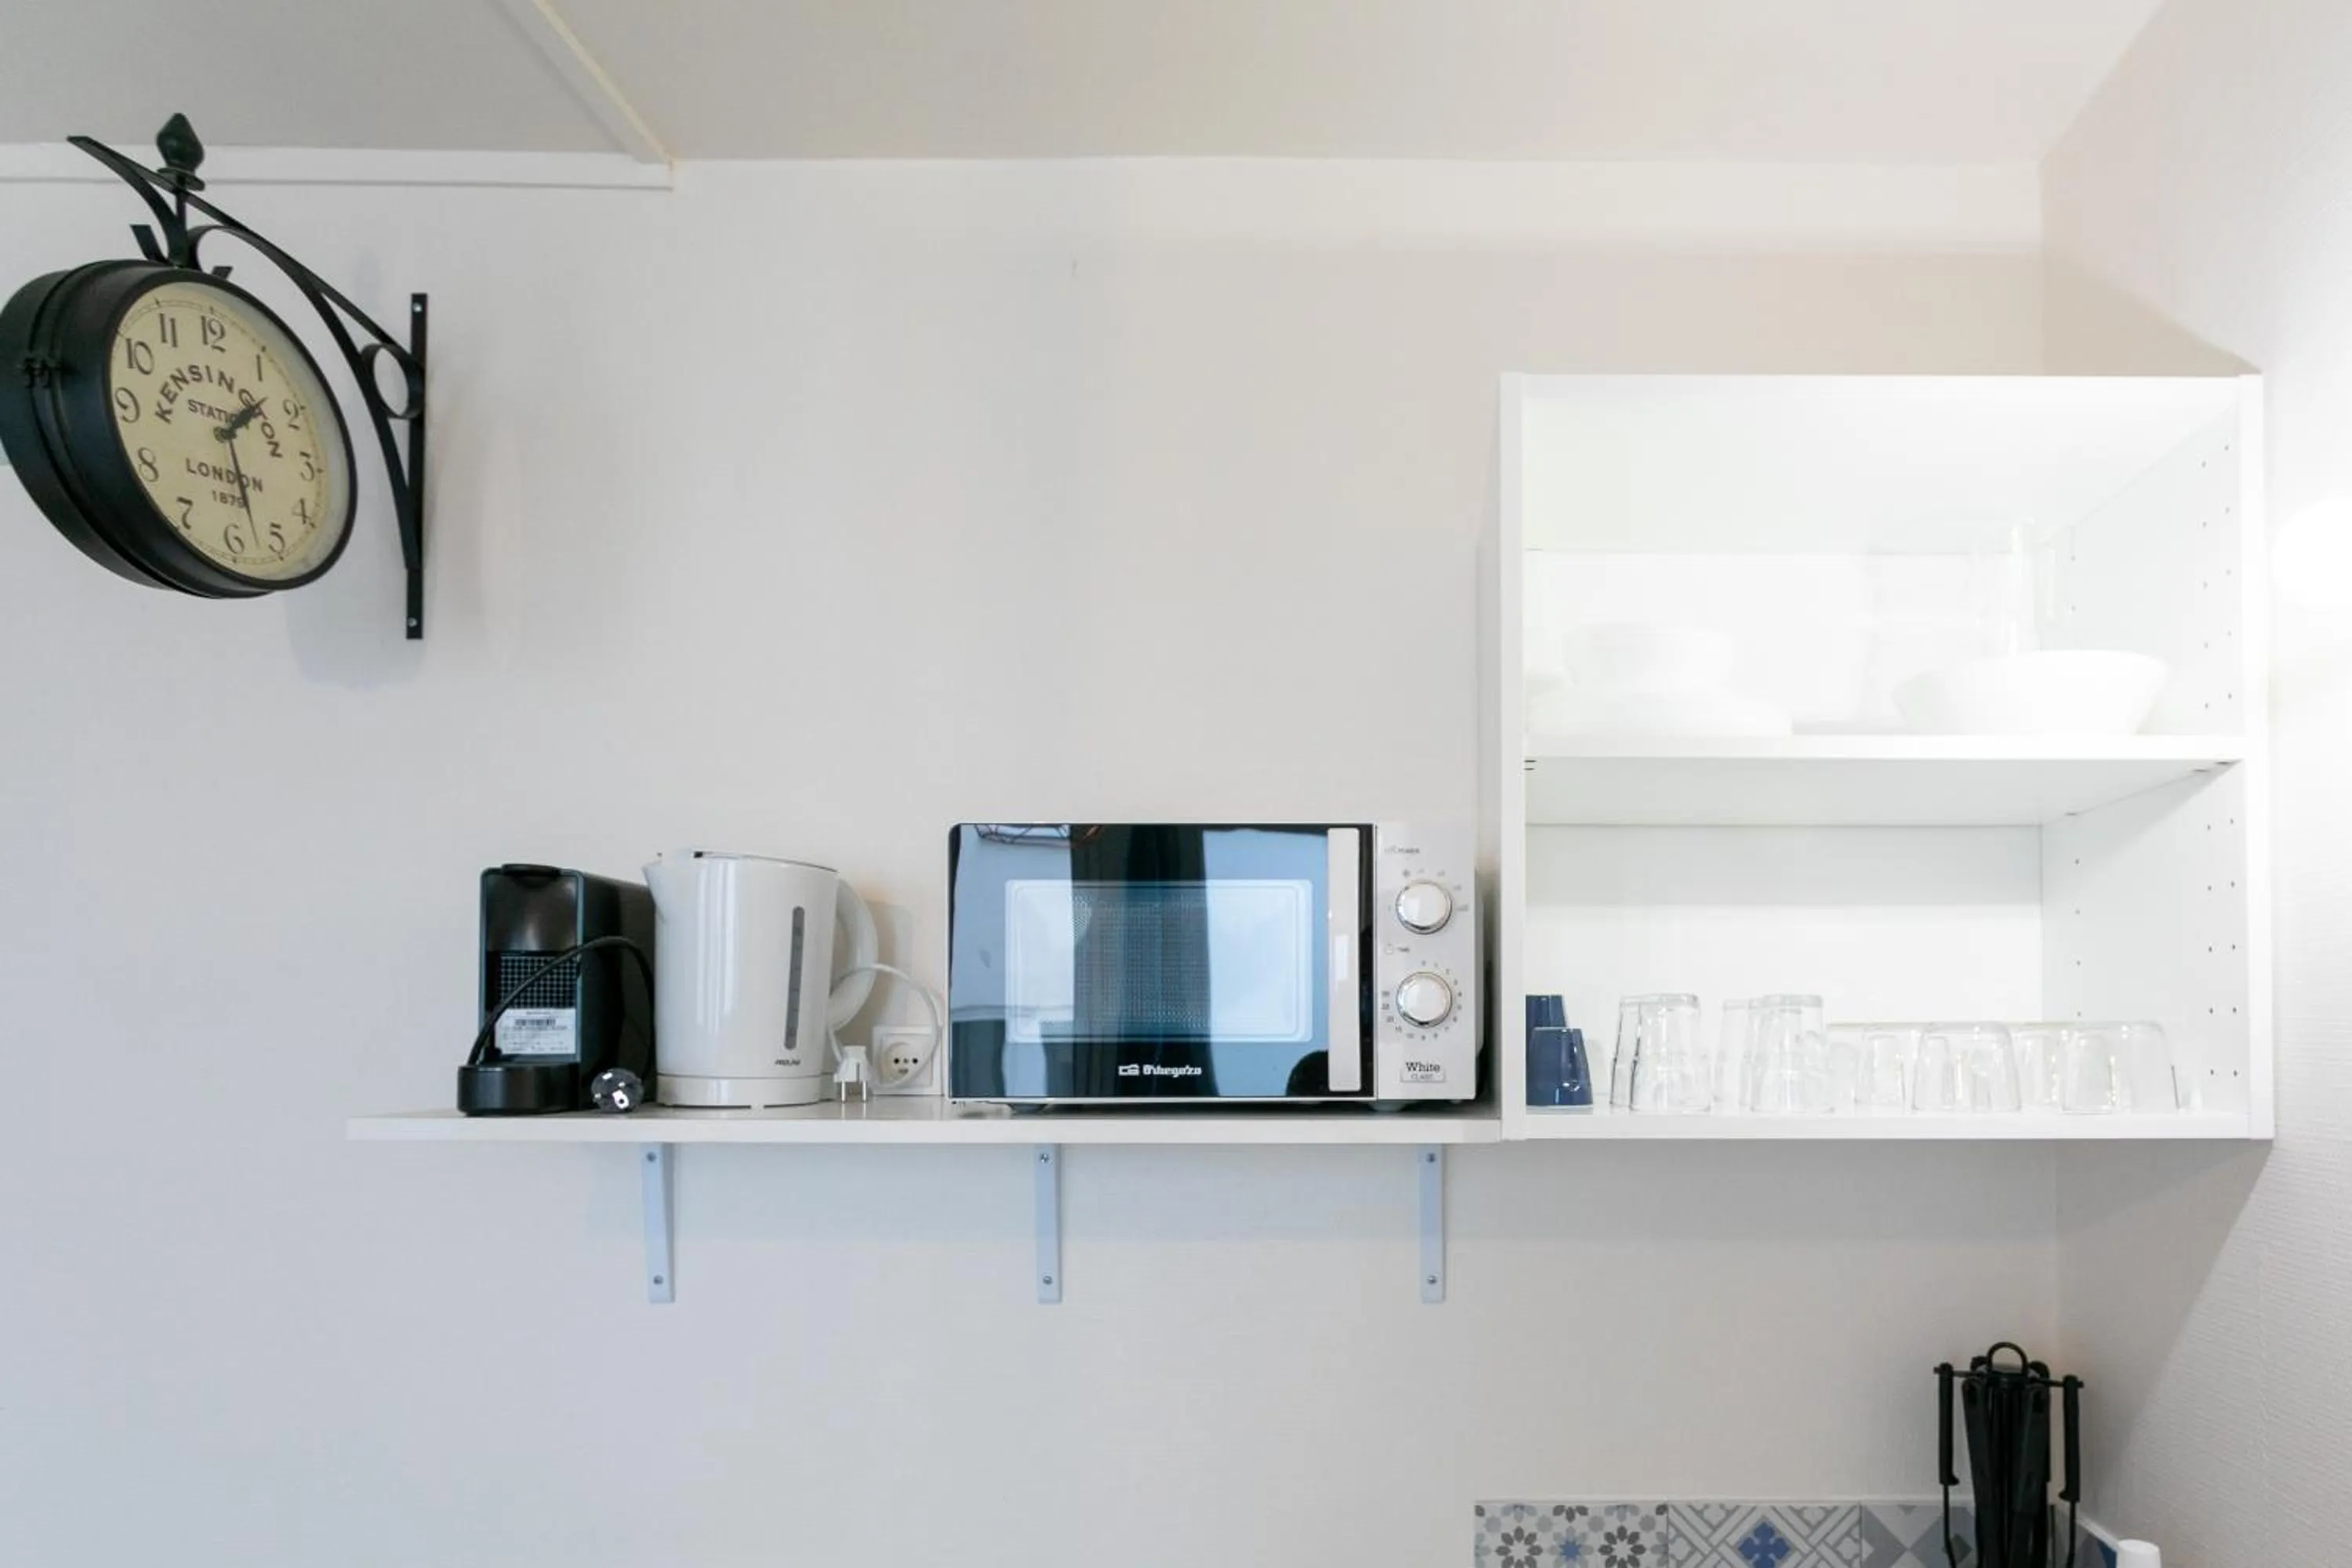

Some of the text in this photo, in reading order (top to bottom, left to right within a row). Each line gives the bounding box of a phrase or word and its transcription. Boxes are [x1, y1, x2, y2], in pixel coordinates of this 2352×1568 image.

[158, 313, 179, 348] 11
[201, 314, 227, 353] 12
[125, 337, 154, 376] 10
[255, 353, 264, 383] 1
[114, 387, 140, 423] 9
[282, 398, 301, 431] 2
[137, 447, 159, 483] 8
[185, 457, 264, 493] LONDON
[299, 451, 315, 482] 3
[176, 496, 194, 530] 7
[291, 497, 311, 525] 4
[223, 523, 245, 555] 6
[268, 521, 286, 555] 5
[1405, 1061, 1441, 1073] White
